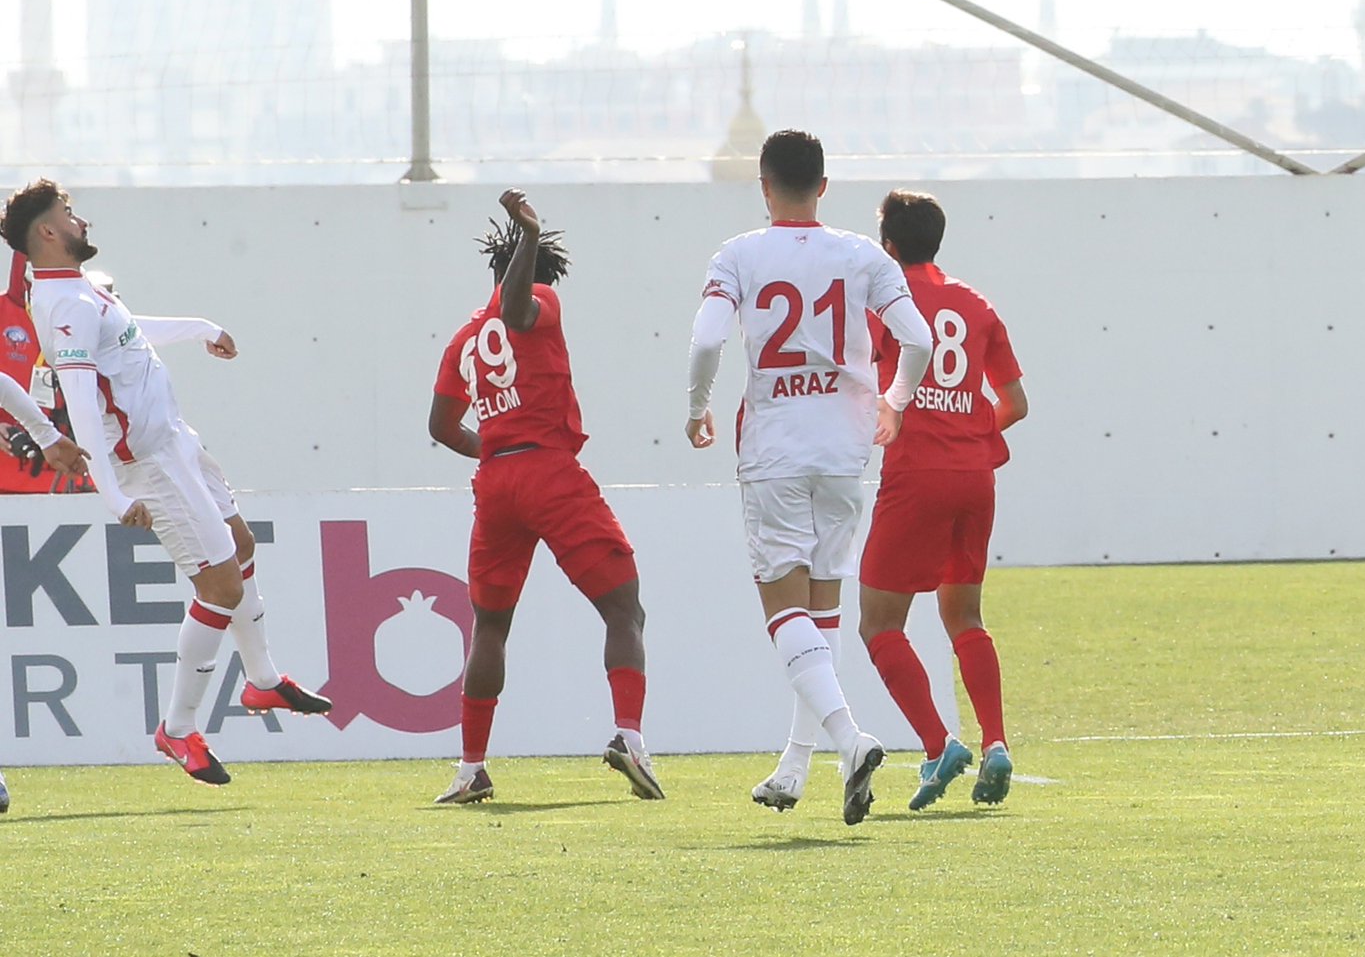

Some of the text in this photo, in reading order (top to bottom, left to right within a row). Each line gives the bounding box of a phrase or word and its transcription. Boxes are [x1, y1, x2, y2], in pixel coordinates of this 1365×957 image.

[756, 279, 846, 369] 21
[475, 386, 521, 421] ELOM
[772, 371, 839, 398] ARAZ
[915, 386, 973, 414] SERKAN
[1, 521, 275, 628] KE
[11, 650, 283, 738] RTA
